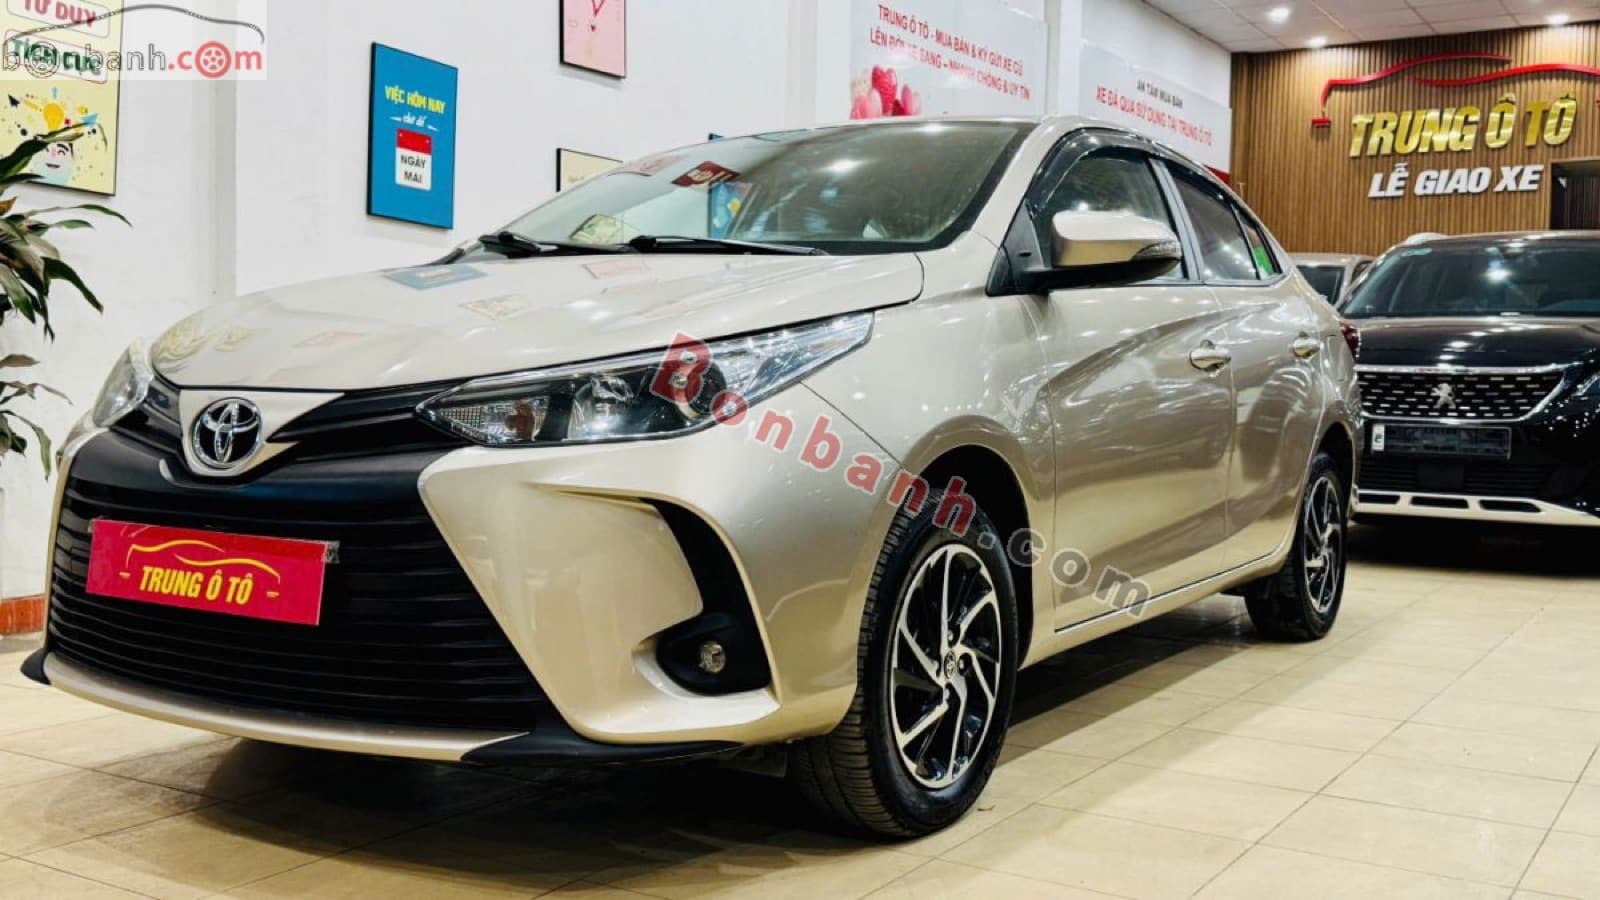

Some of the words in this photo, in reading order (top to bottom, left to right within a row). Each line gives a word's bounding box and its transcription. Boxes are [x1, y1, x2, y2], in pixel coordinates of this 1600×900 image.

[55, 1, 96, 27] DUY
[870, 26, 888, 48] LÊN
[919, 48, 942, 69] SANG
[878, 4, 908, 30] TRUNG
[909, 15, 917, 33] Ô
[918, 21, 929, 39] TÔ
[936, 27, 953, 48] MUA
[954, 36, 970, 56] BÁN
[1003, 58, 1013, 72] XE
[384, 84, 406, 105] VIỆC
[406, 90, 428, 110] HÔM
[427, 97, 446, 115] NAY
[1096, 84, 1107, 104] XE
[1349, 106, 1481, 158] TRUNG
[1485, 93, 1517, 149] Ô
[1525, 94, 1577, 147] TÔ
[400, 154, 426, 169] NGÀY
[404, 170, 422, 184] MAI
[1368, 162, 1409, 198] LỄ
[1414, 166, 1493, 197] GIAO
[1494, 164, 1544, 193] XE
[140, 565, 203, 598] TRUNG
[205, 569, 224, 601] Ô
[225, 572, 254, 605] TÔ
